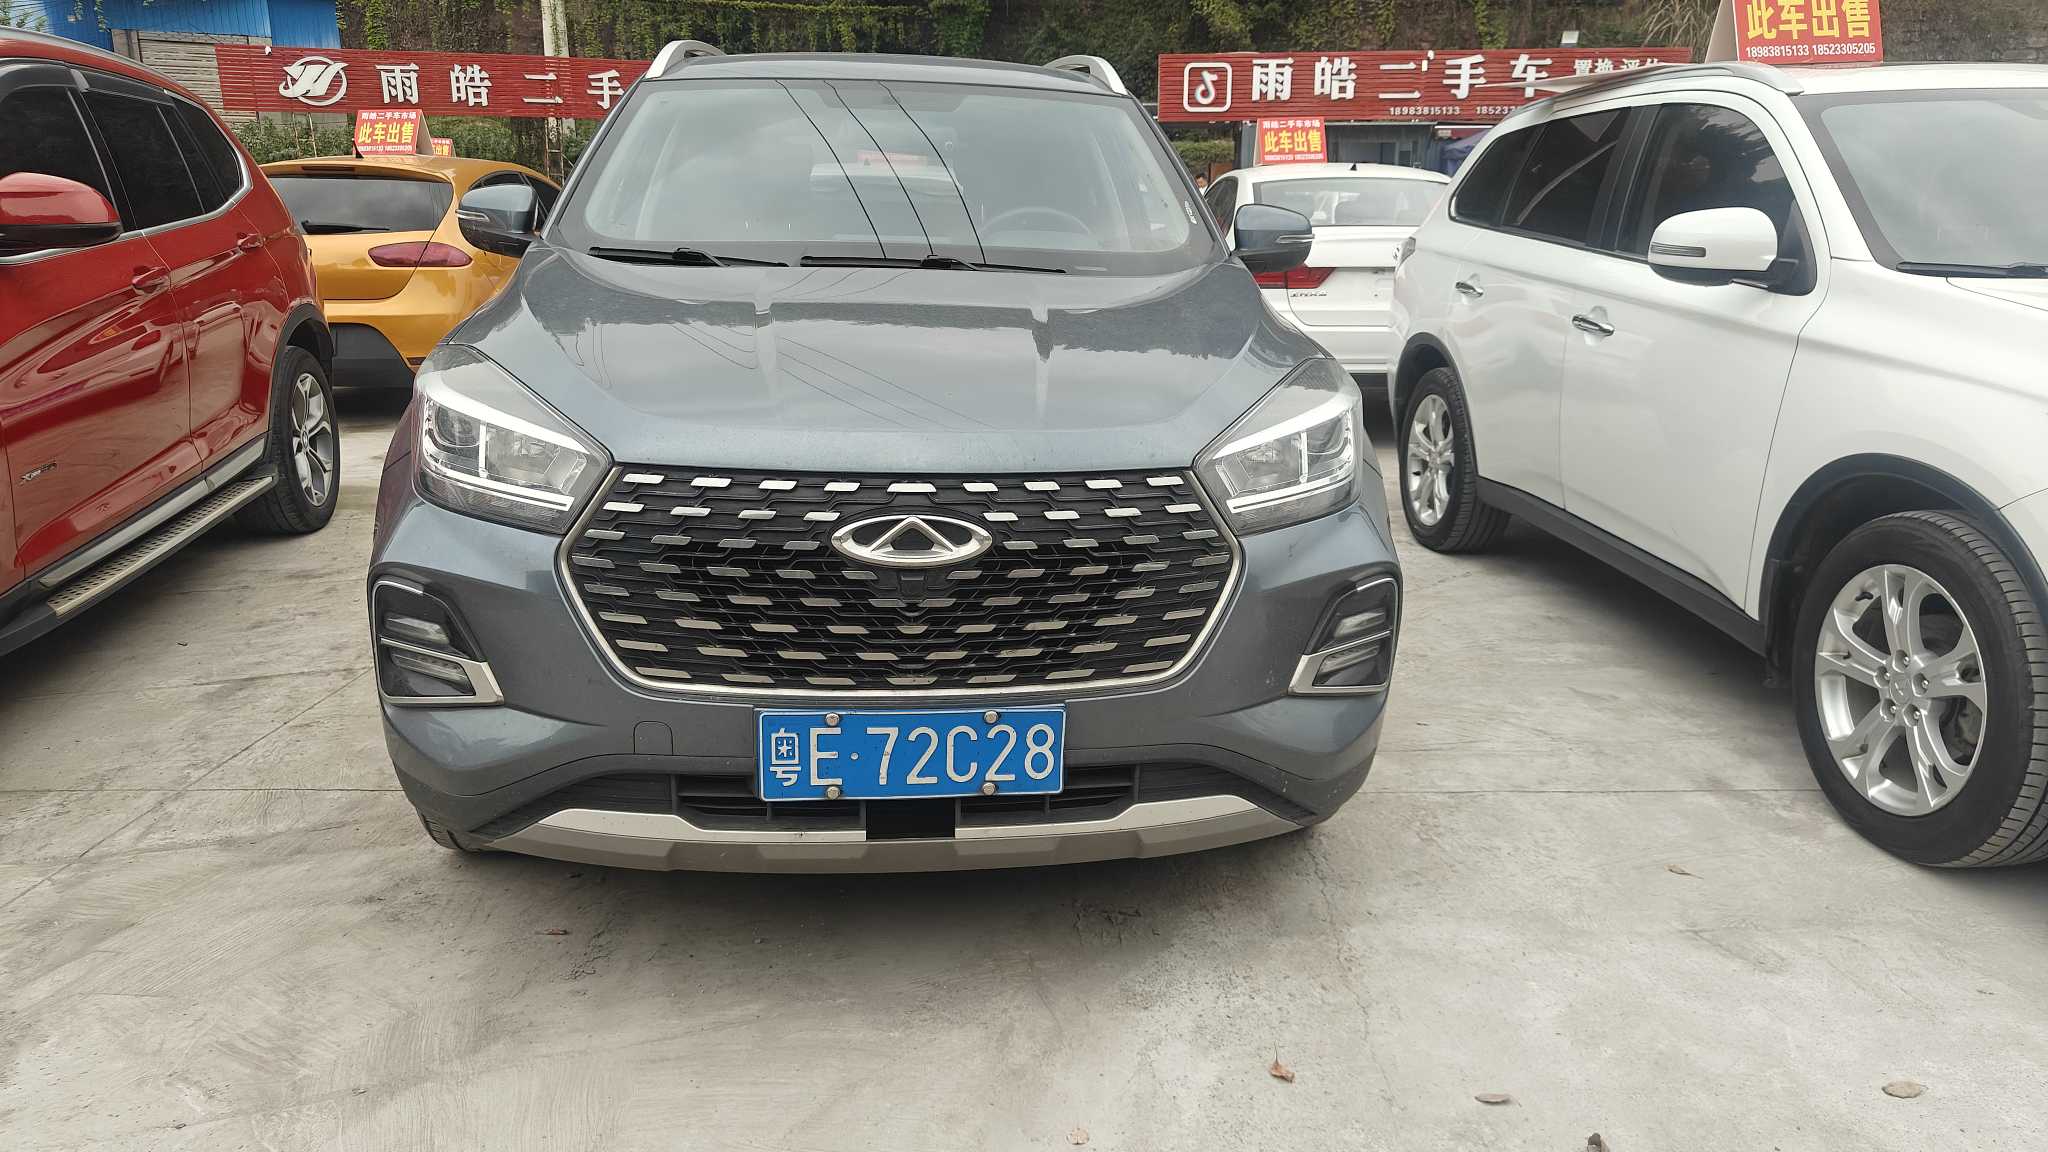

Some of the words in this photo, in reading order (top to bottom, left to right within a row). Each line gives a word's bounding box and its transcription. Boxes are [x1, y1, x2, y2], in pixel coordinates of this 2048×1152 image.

[1746, 0, 1871, 39] 此车出售
[1746, 45, 1809, 58] 18983815133
[1812, 42, 1876, 56] 18523305205
[1389, 106, 1461, 116] 18983815133
[357, 121, 415, 144] 此车出售
[1264, 128, 1322, 153] 此车出售
